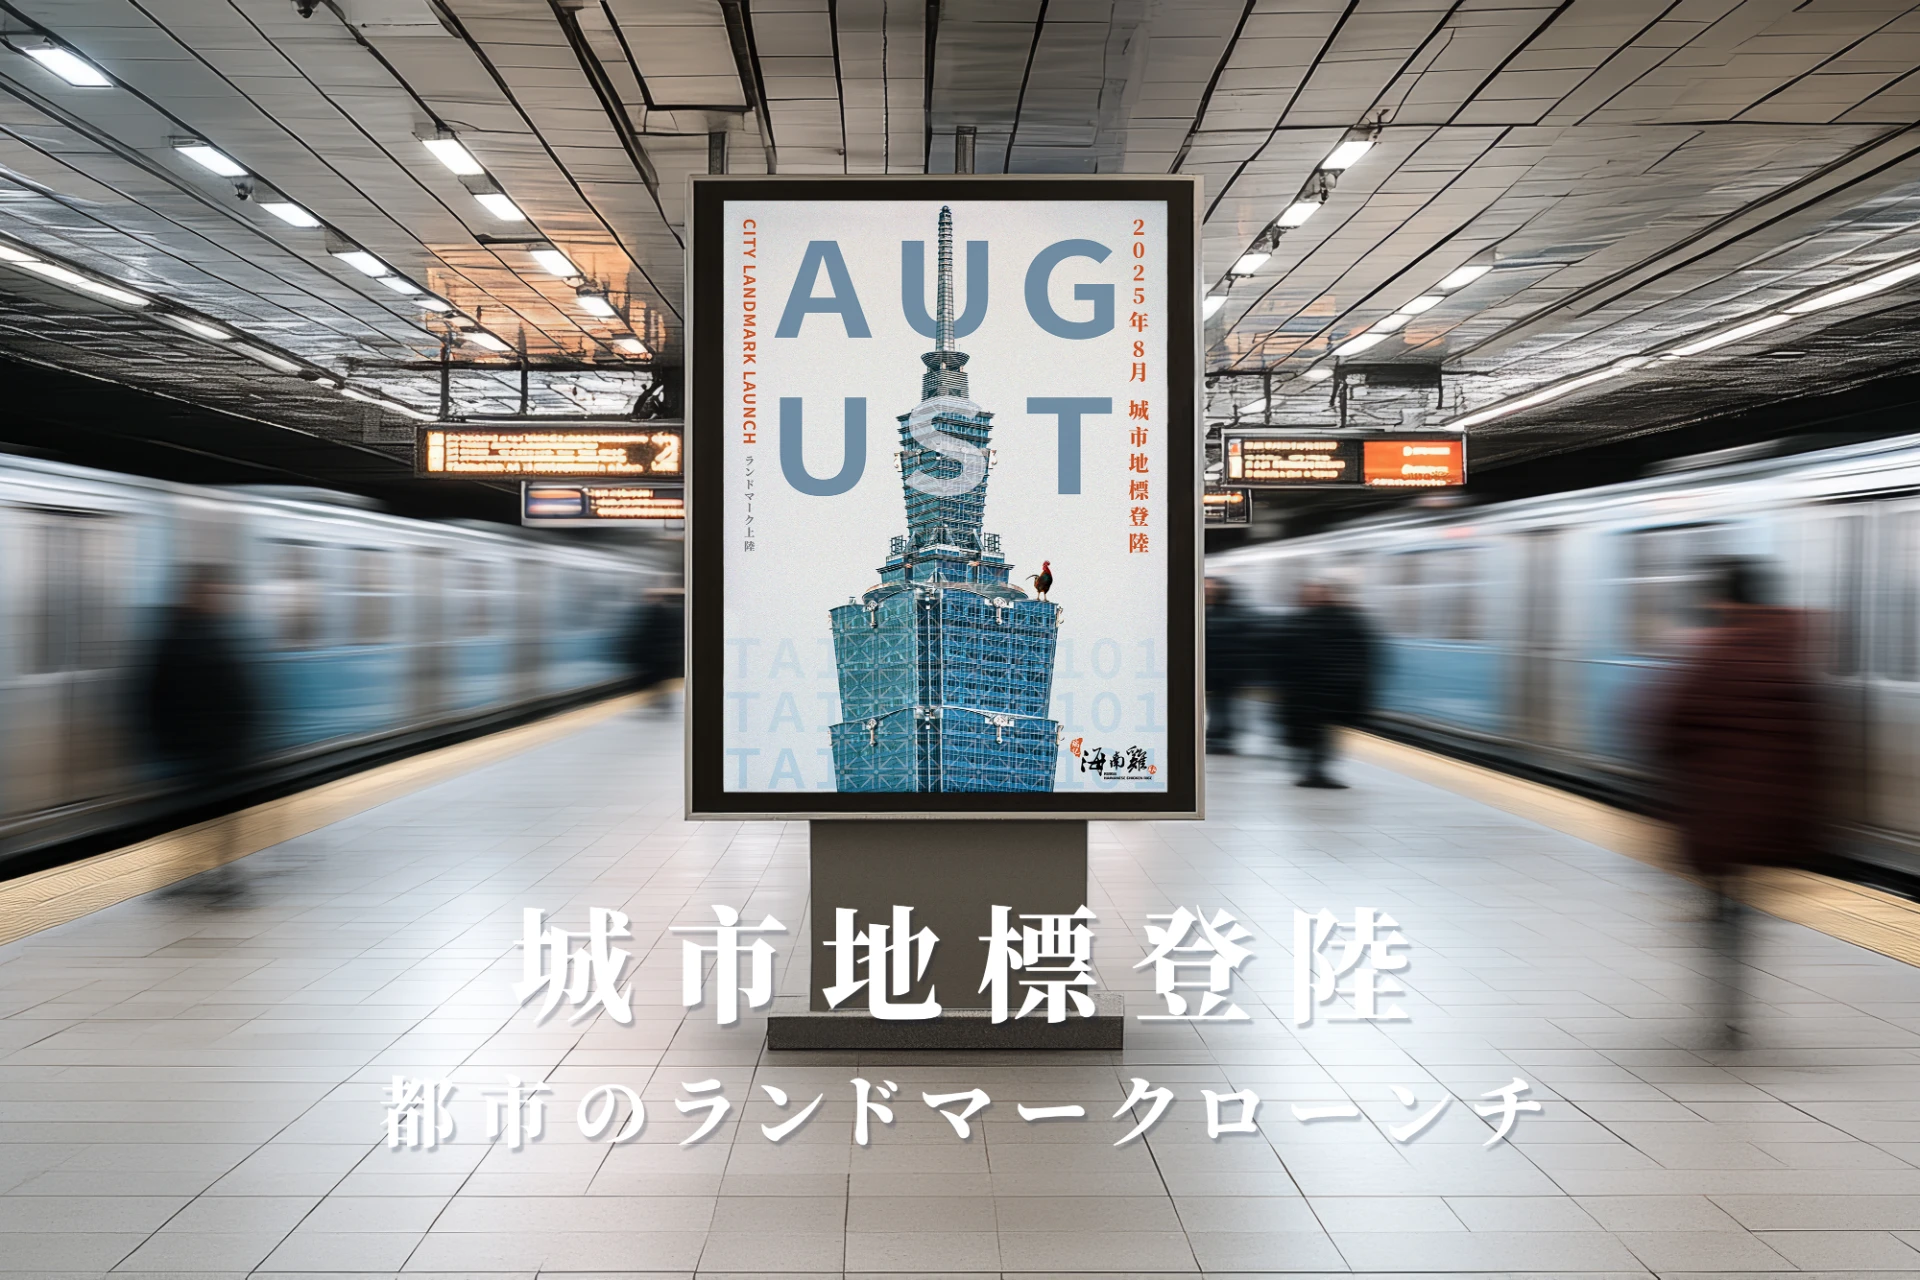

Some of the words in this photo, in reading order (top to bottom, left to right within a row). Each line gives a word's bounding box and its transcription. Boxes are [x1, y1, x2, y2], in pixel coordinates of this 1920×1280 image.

[742, 218, 757, 259] CITY
[742, 265, 757, 365] LANDMARK
[1129, 218, 1149, 383] 2025年8月
[742, 371, 757, 444] LAUNCH
[744, 455, 755, 553] ランドマーク上陸
[1128, 399, 1149, 554] 城市地標登陸
[1056, 637, 1165, 679] 101
[1056, 691, 1165, 733] 101
